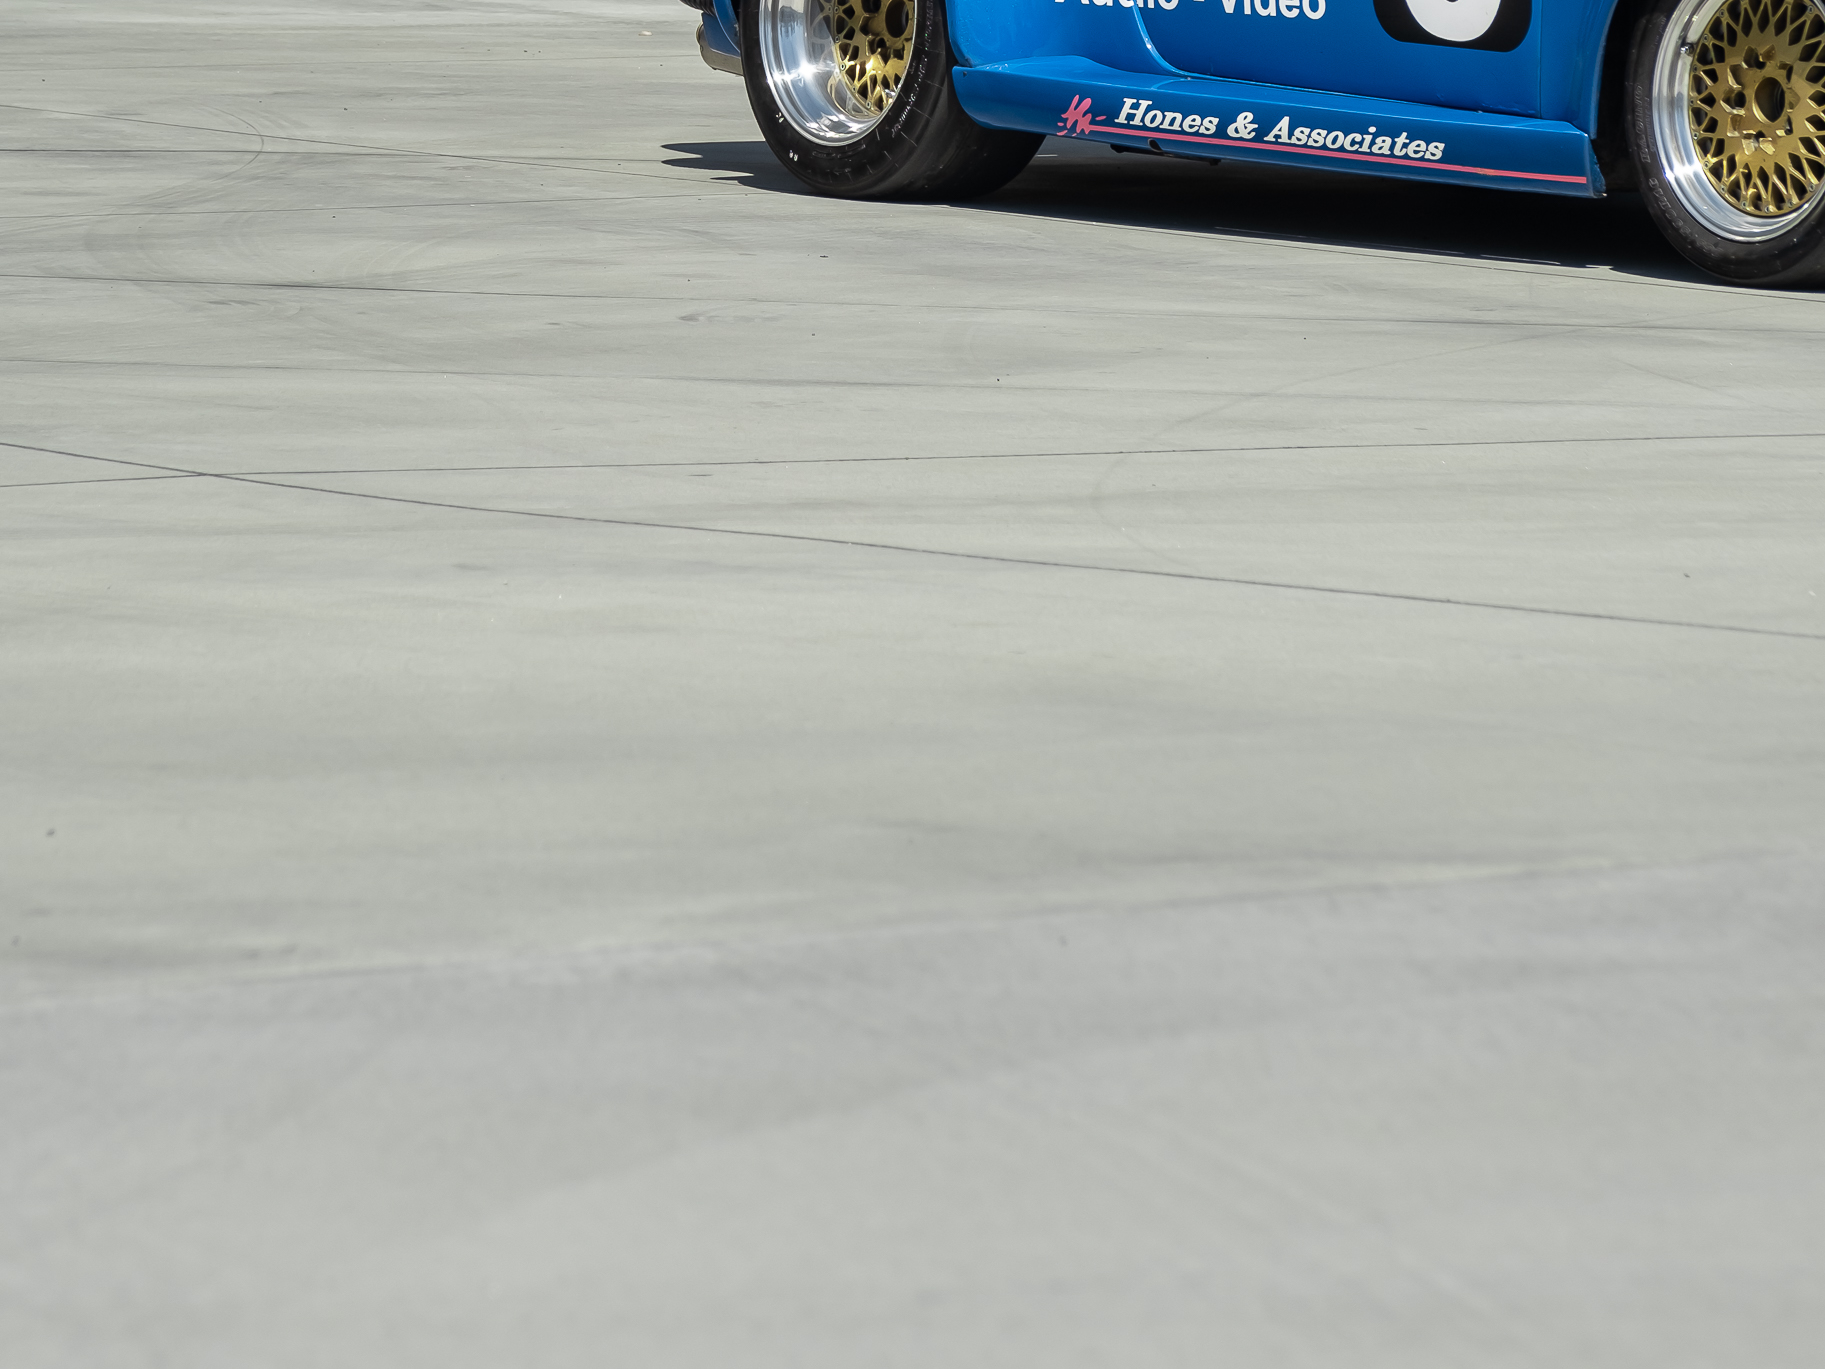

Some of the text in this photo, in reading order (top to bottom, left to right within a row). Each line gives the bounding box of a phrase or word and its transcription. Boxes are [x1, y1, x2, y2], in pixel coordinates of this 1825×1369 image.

[1114, 97, 1445, 160] Hones & Associates
